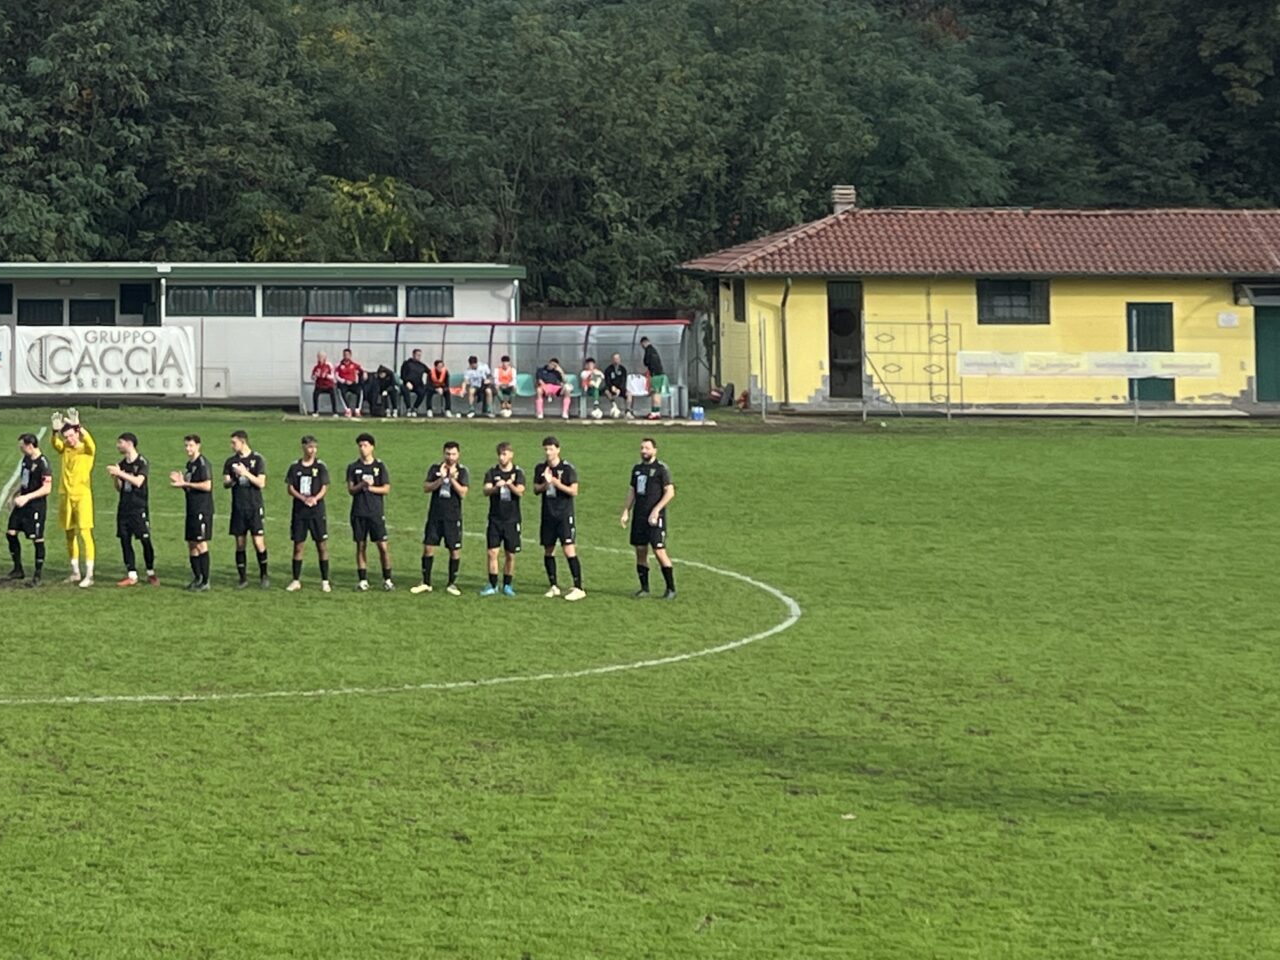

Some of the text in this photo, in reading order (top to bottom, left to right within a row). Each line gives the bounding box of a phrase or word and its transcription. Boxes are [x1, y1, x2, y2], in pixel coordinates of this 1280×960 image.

[84, 330, 157, 345] GRUPPO
[48, 345, 185, 376] CACCIA
[76, 377, 185, 389] SERVICES
